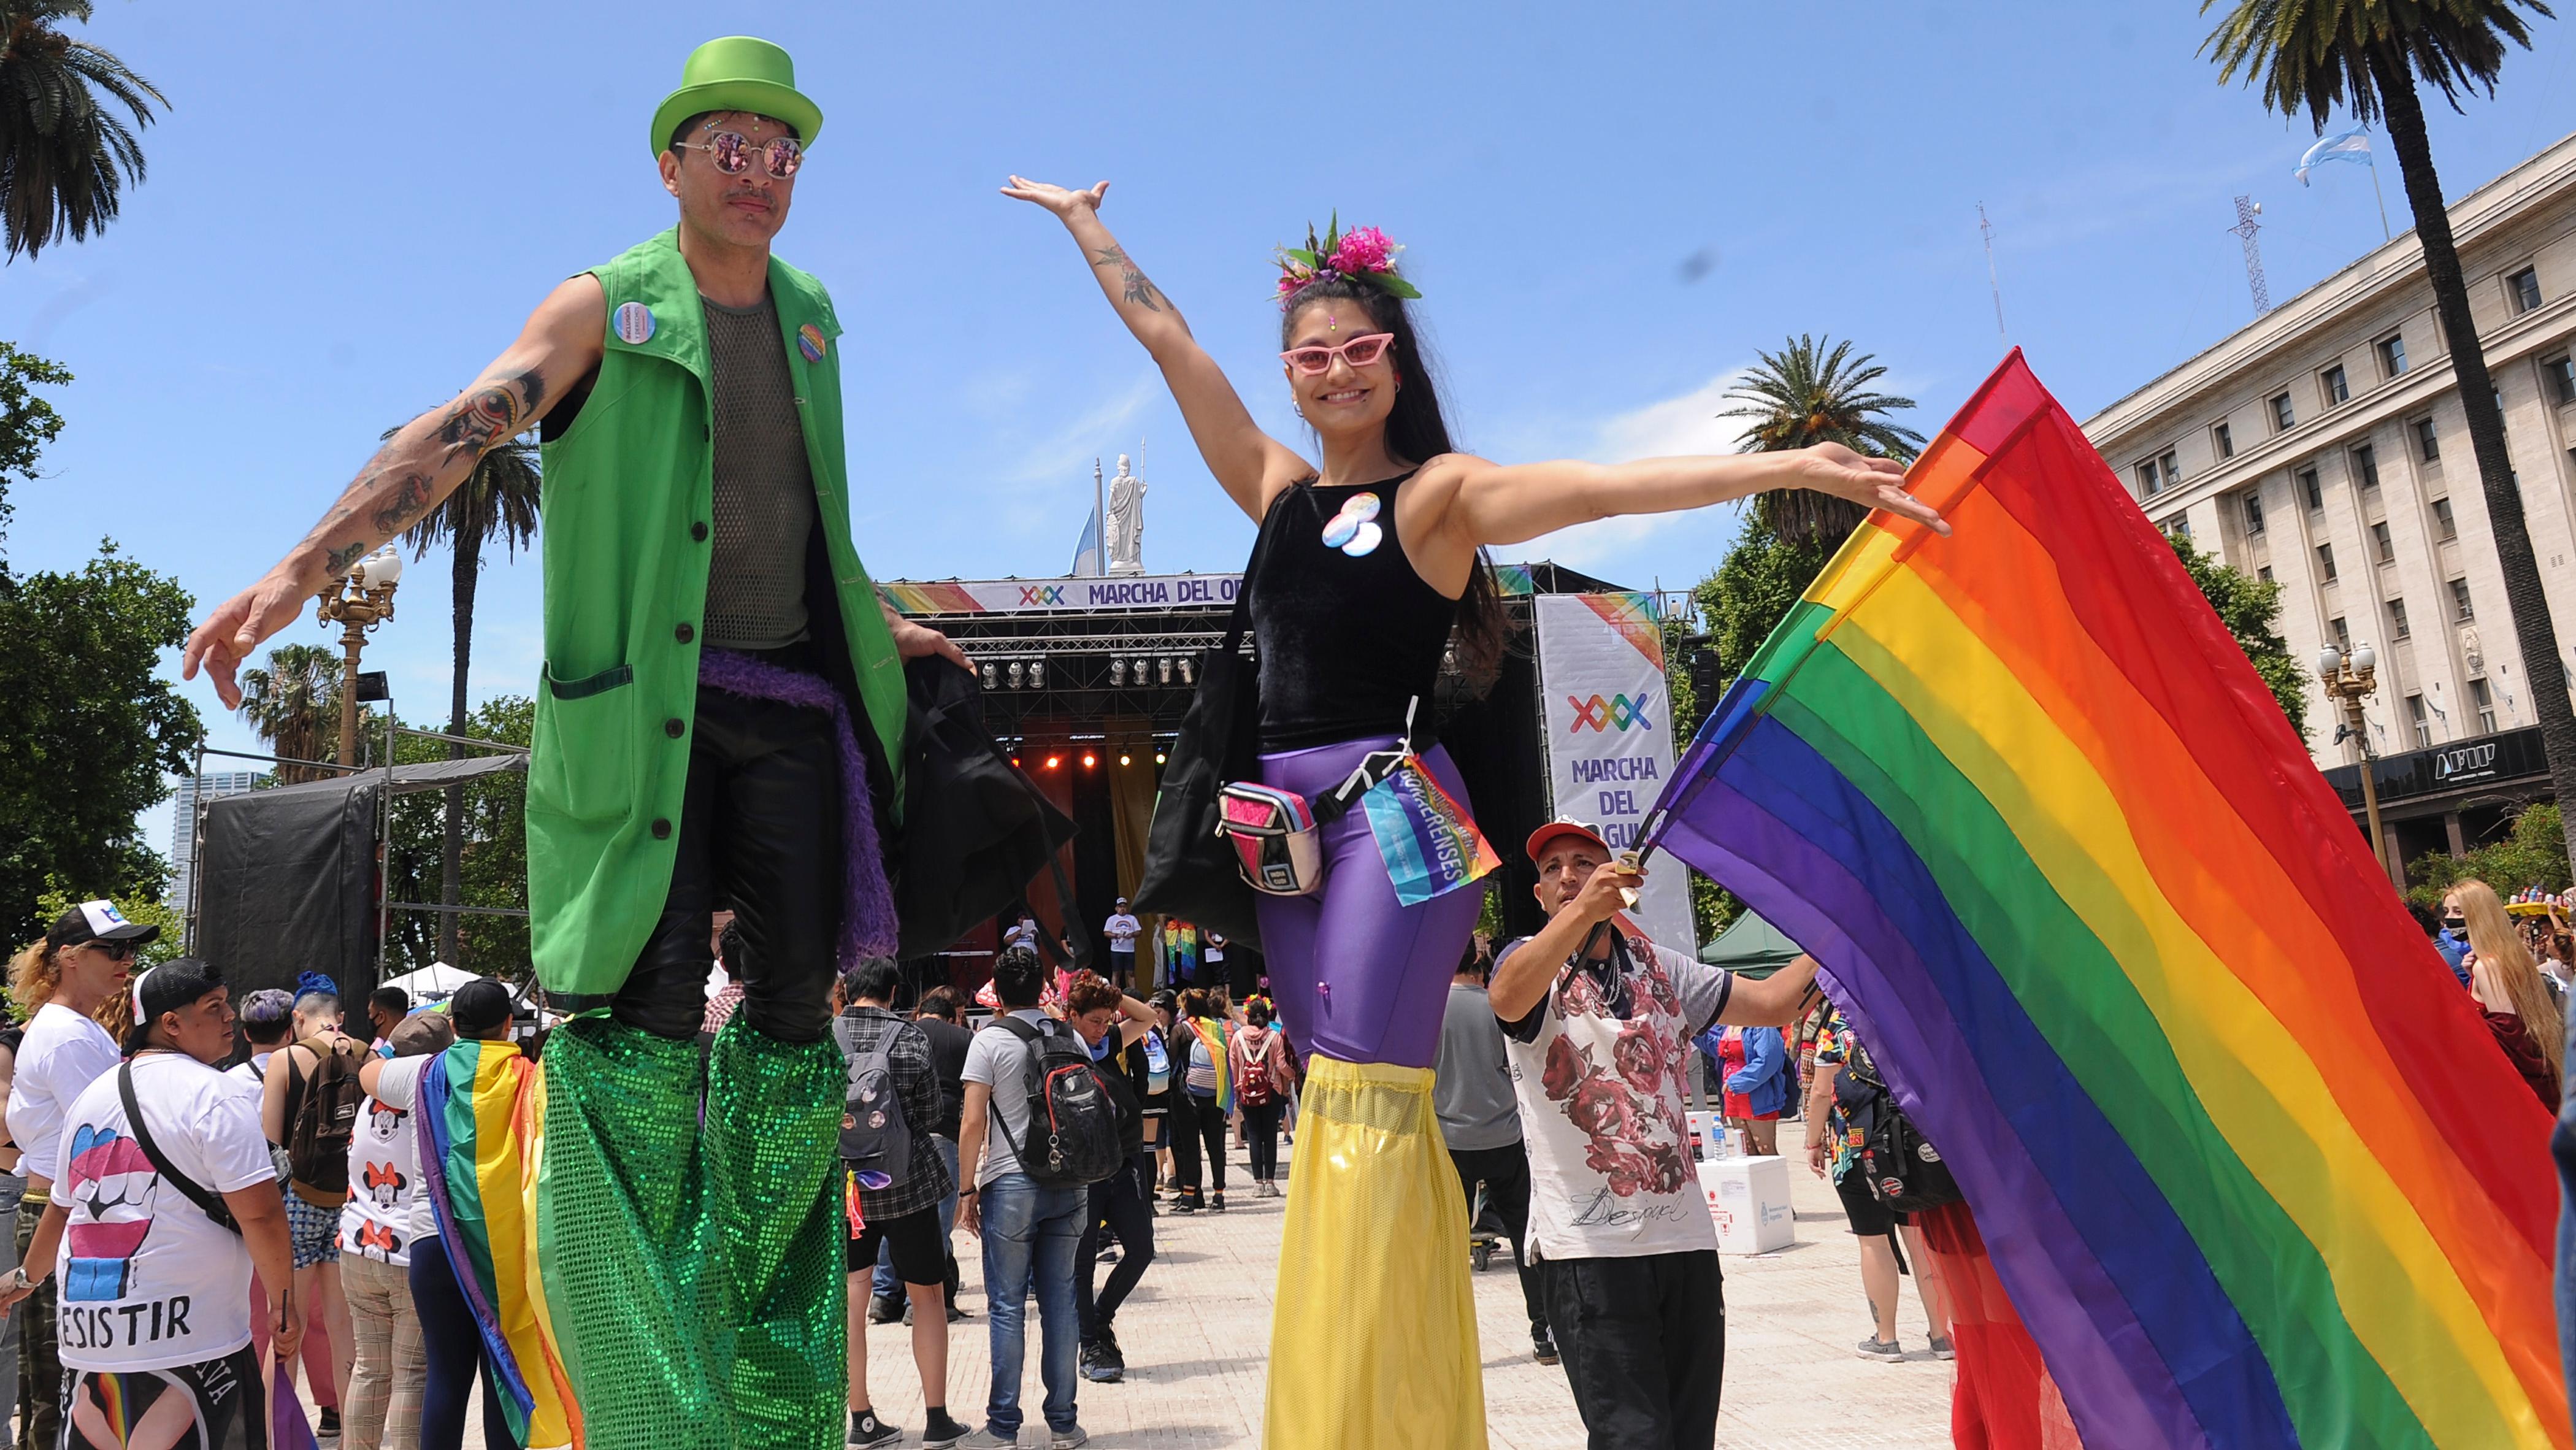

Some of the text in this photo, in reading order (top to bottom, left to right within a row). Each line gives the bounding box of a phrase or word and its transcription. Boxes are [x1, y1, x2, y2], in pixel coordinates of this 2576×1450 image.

[1089, 583, 1169, 605] MARCHA
[1177, 580, 1213, 602] DEL
[1571, 757, 1658, 783] MARCHA
[2436, 743, 2495, 780] AFIP
[1599, 790, 1639, 816] DEL
[1398, 769, 1464, 881] BONAERENSES
[58, 1296, 191, 1348] ESISTIR
